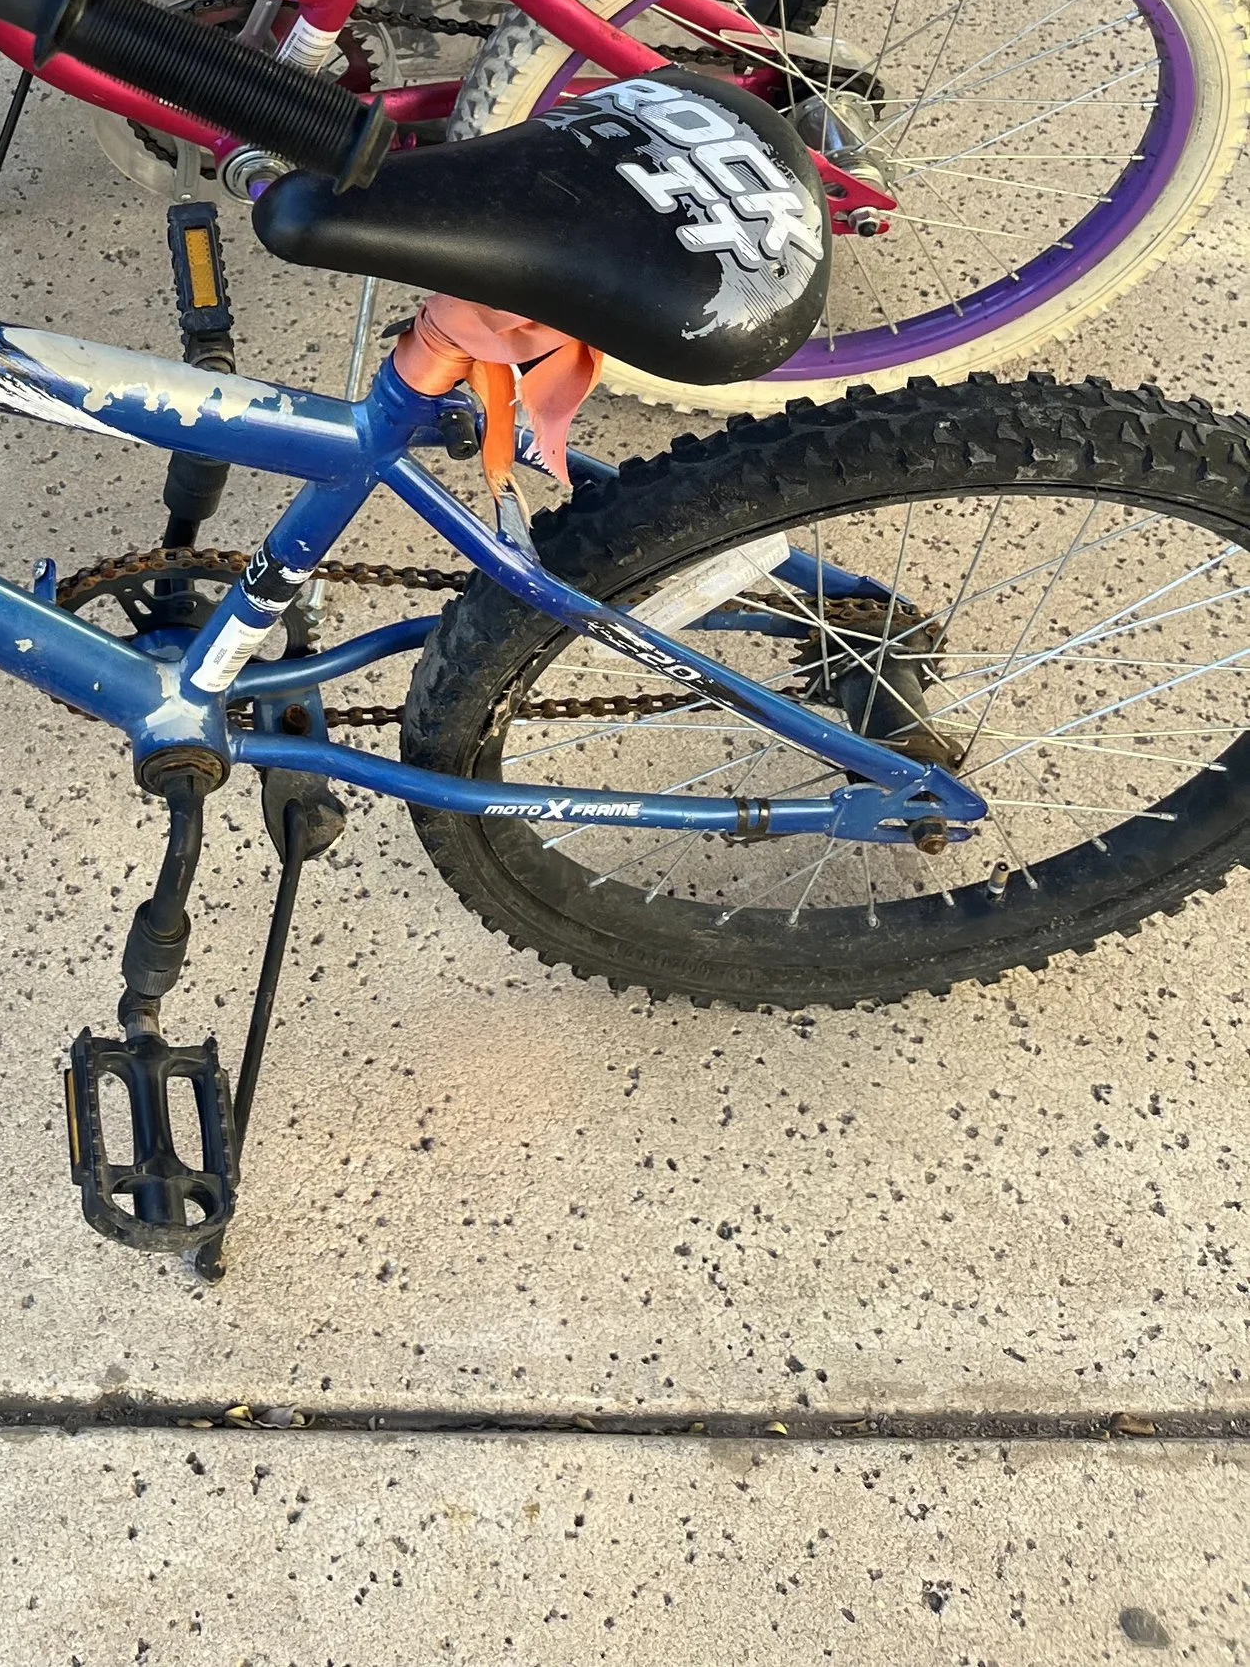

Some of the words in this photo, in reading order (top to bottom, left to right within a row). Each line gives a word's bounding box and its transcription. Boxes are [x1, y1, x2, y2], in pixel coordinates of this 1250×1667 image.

[582, 78, 825, 261] ROCK
[617, 154, 761, 263] IT
[484, 805, 543, 816] MOTO
[569, 803, 642, 817] FRAME
